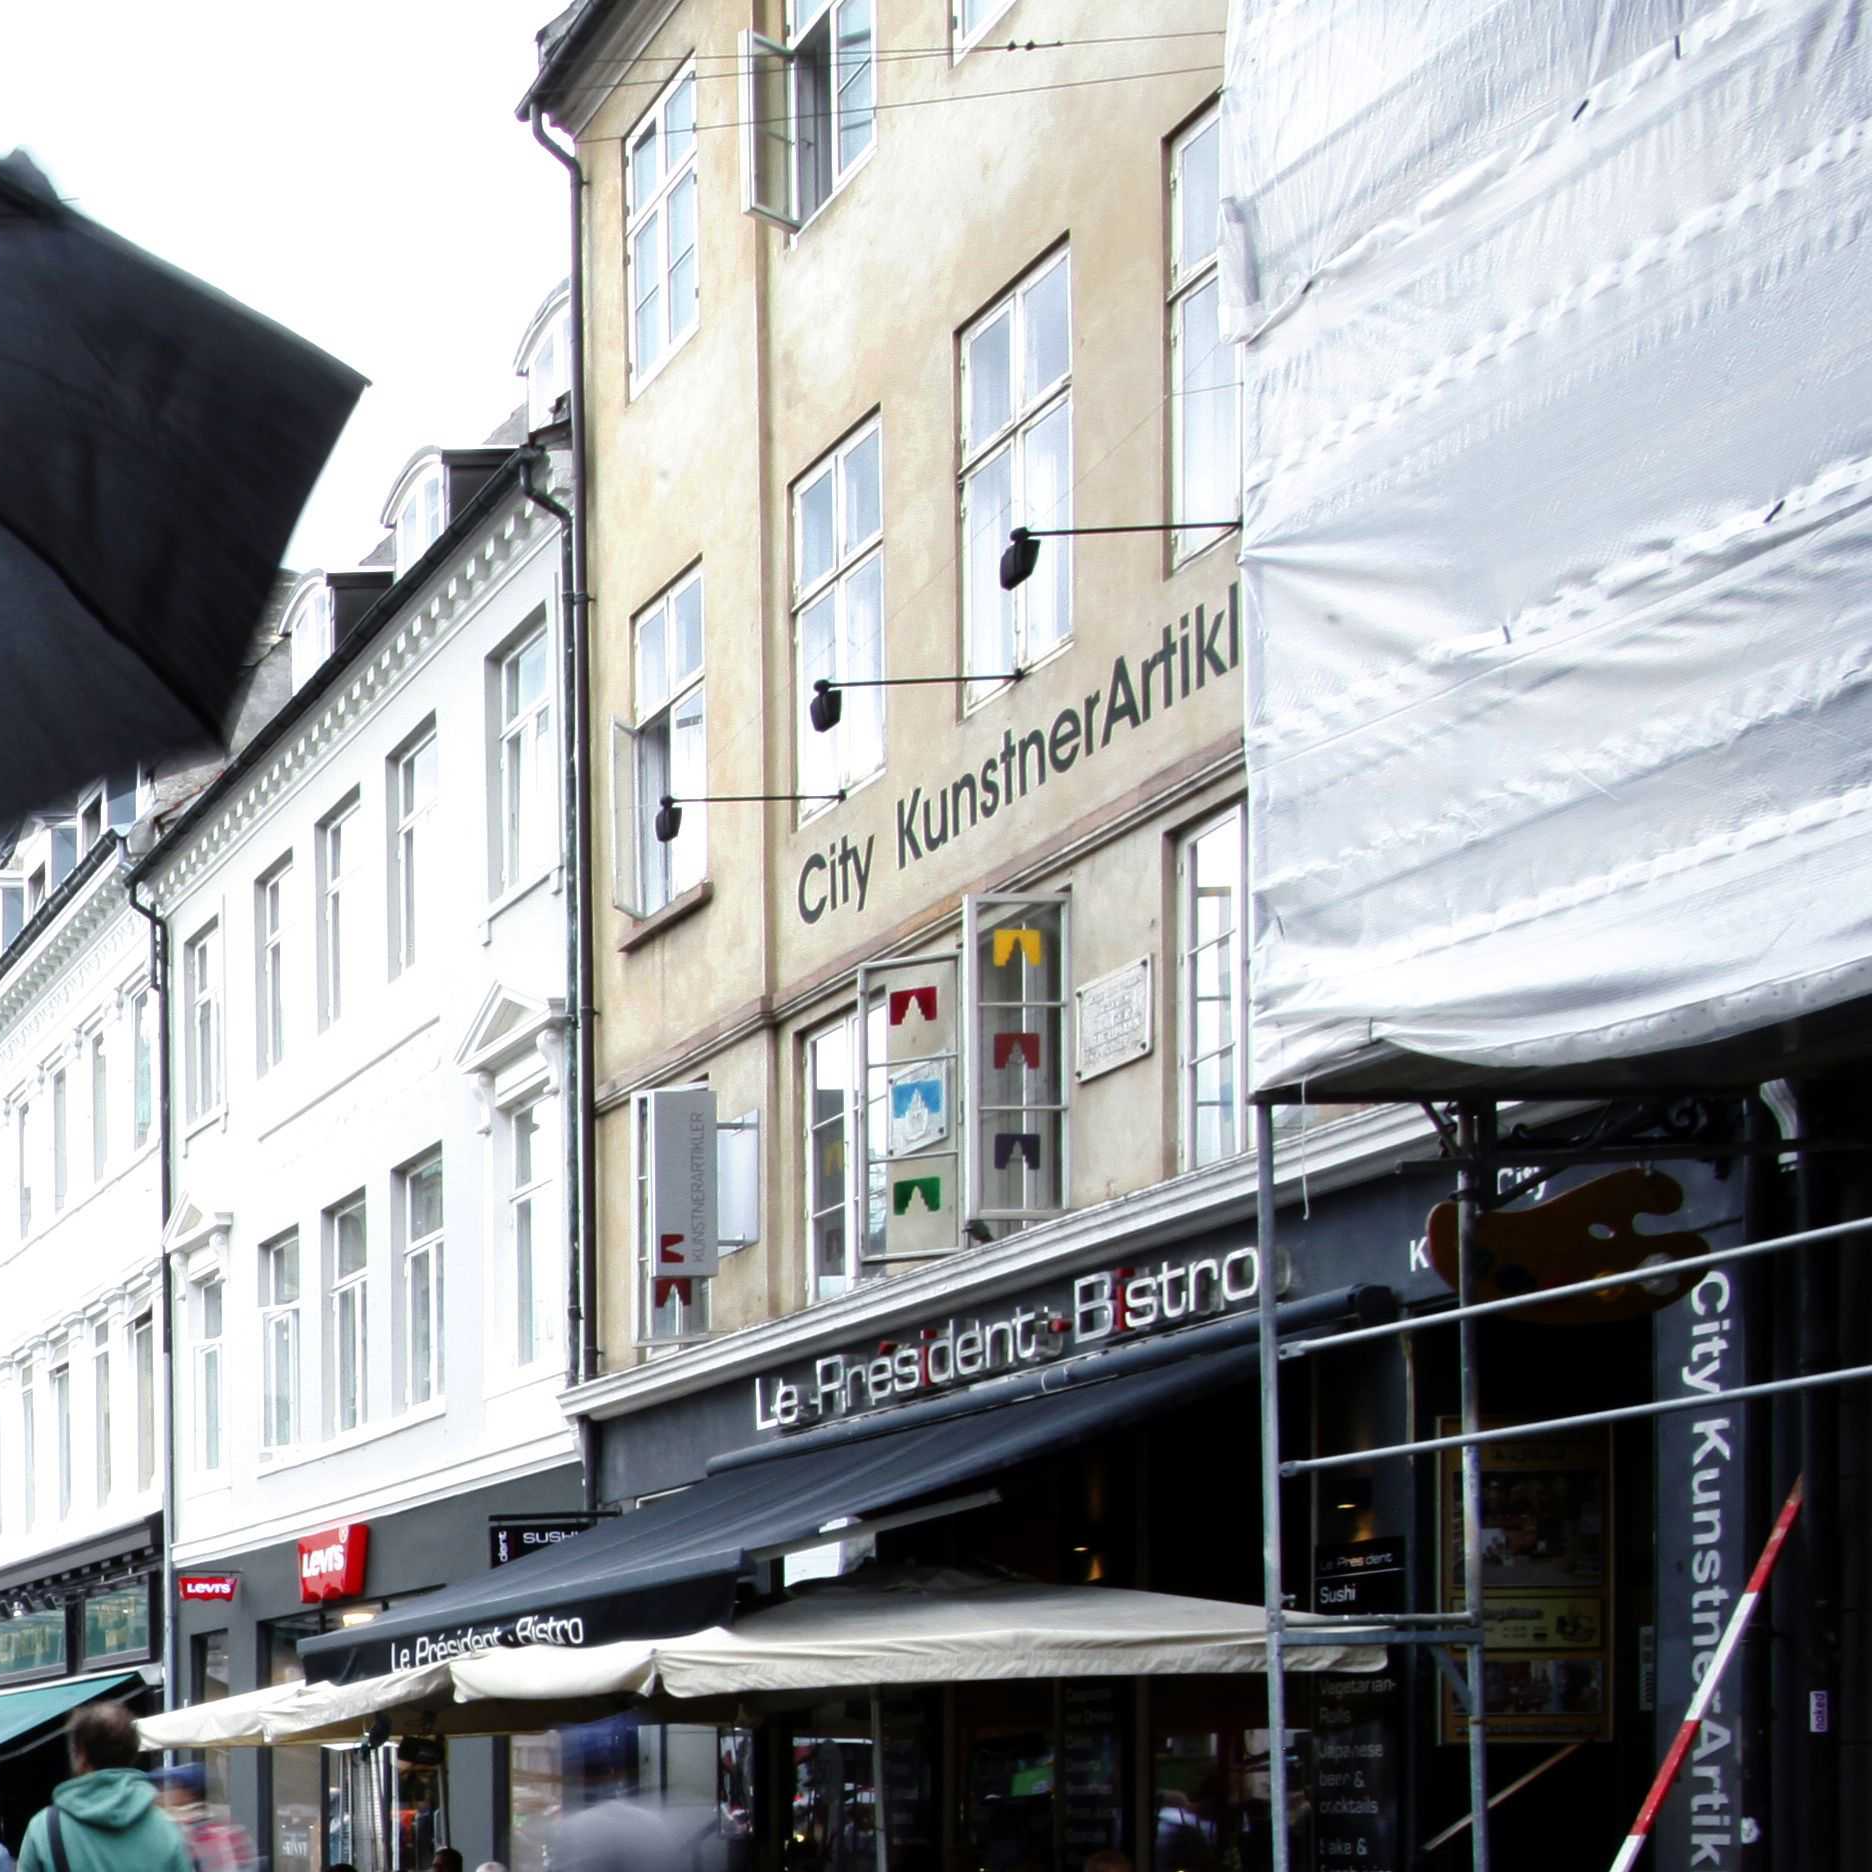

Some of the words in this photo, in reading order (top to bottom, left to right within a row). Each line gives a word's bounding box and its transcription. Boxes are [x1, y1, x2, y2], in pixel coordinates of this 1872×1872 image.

[798, 834, 876, 925] City
[897, 584, 1241, 871] KunstnerArtikl
[689, 1111, 705, 1263] KUNSTNERARTIKLER
[755, 1376, 798, 1431] Le
[1073, 1246, 1261, 1345] Bistro
[1681, 1270, 1731, 1395] City
[522, 1530, 580, 1544] SUSH
[1319, 1583, 1357, 1604] Sushi
[390, 1642, 411, 1674] Le
[1356, 1837, 1369, 1856] &
